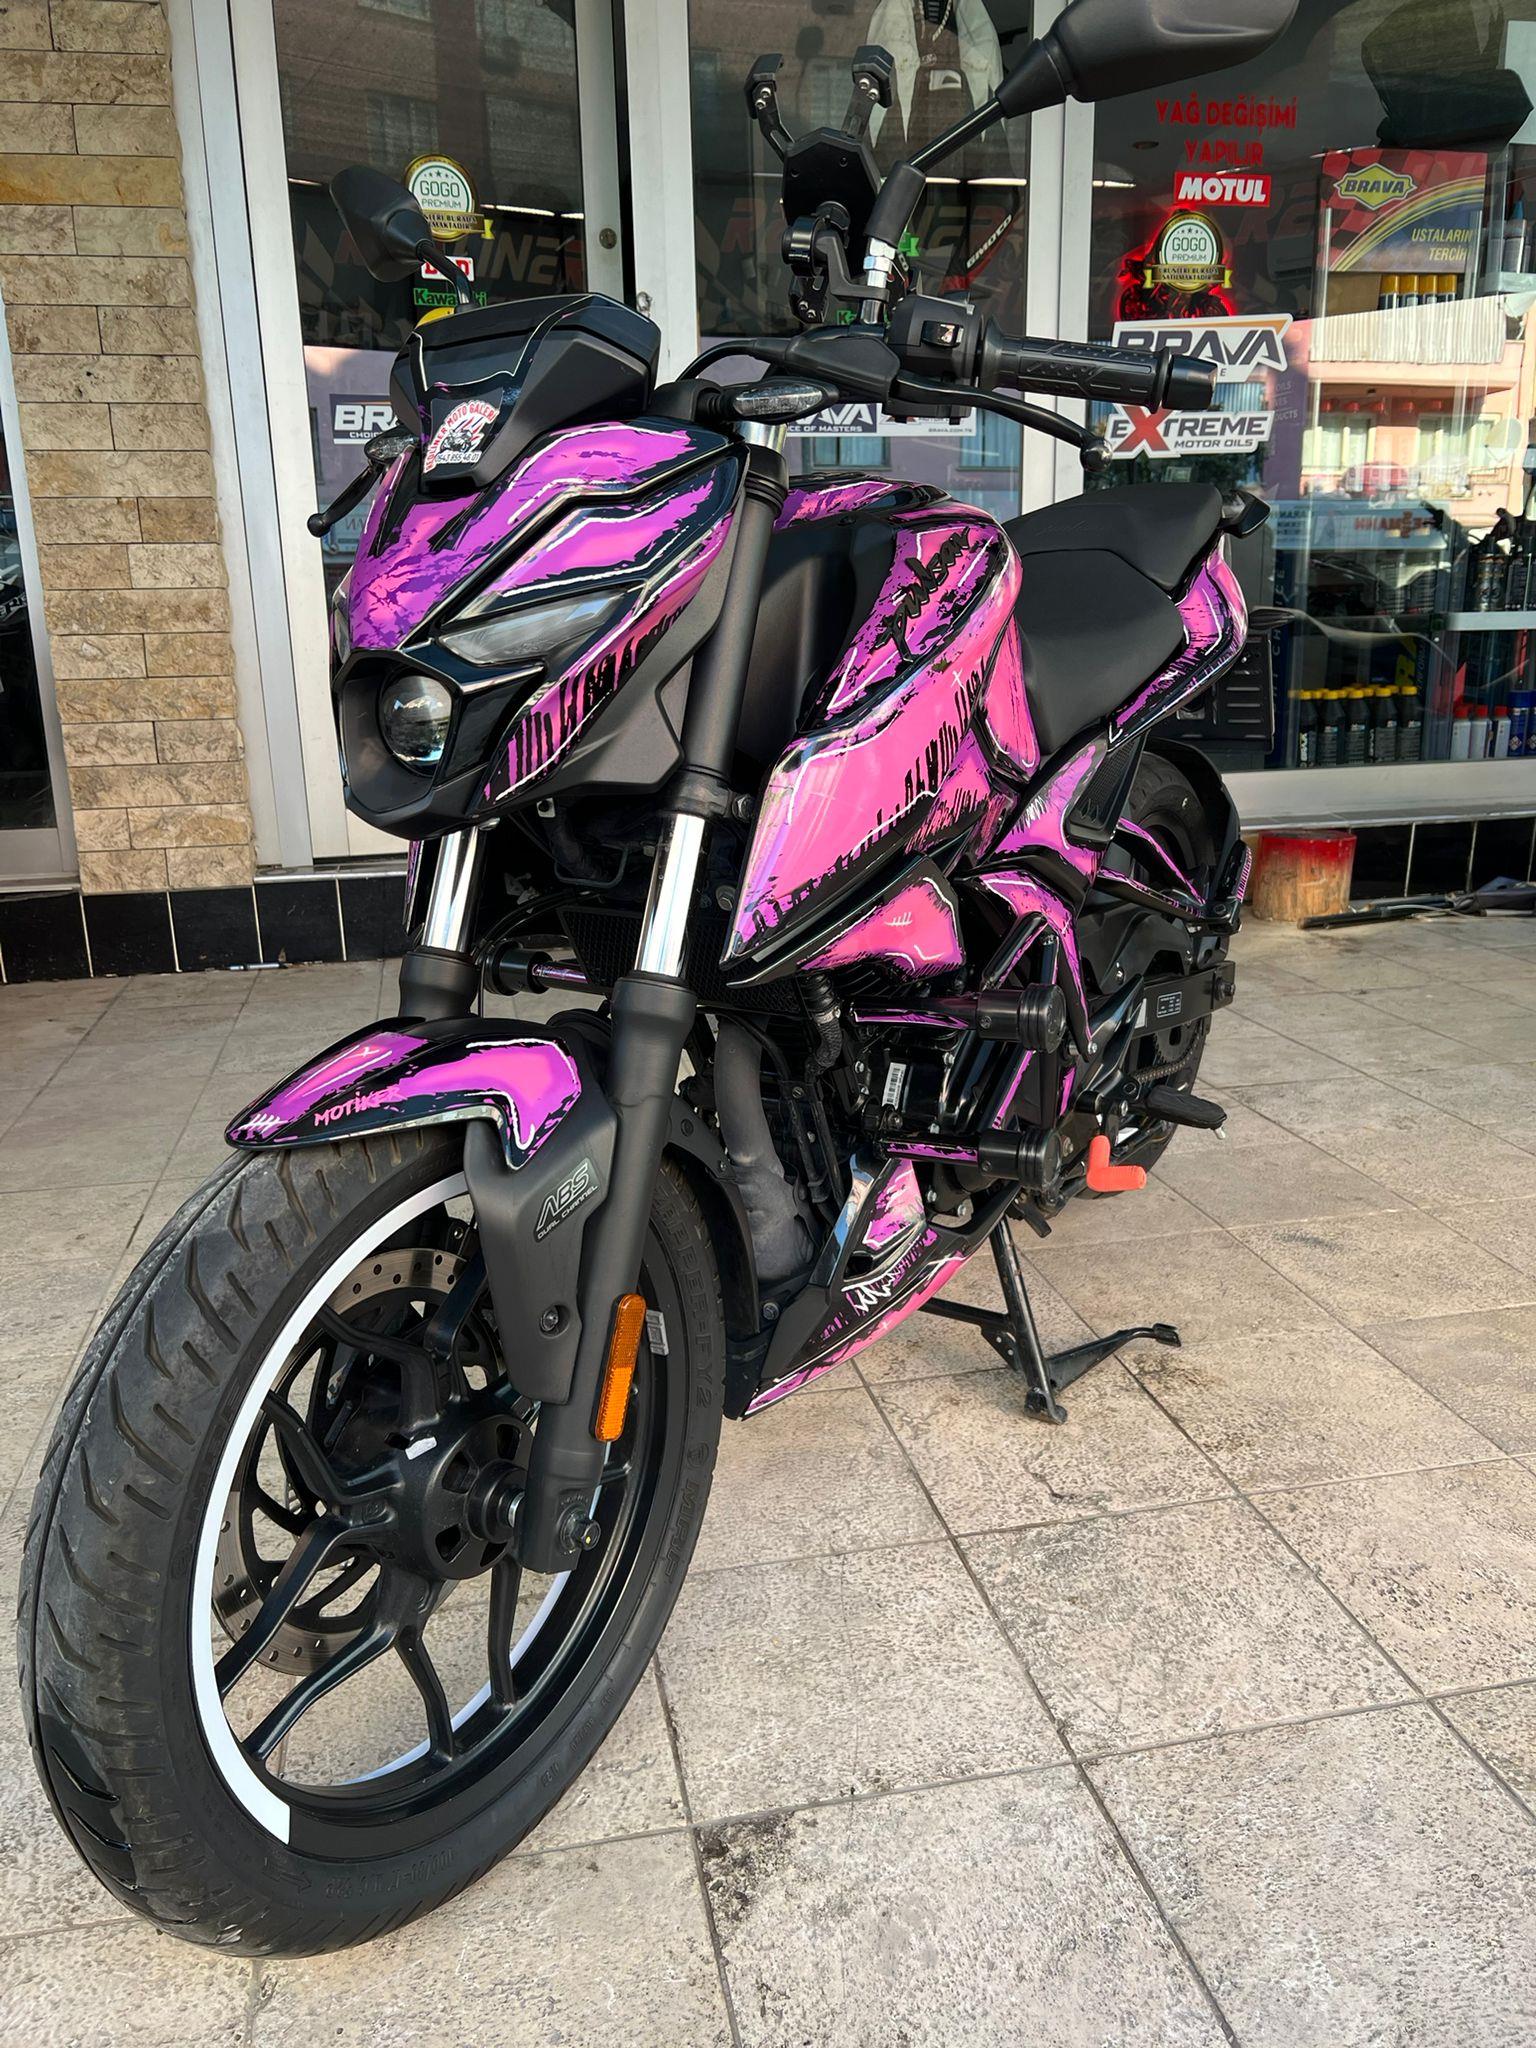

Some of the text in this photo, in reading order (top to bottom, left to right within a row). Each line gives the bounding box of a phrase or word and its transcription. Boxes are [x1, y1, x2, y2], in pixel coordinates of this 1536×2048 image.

[1184, 138, 1264, 166] YAPILIR
[420, 180, 460, 198] GOGO
[1178, 176, 1266, 202] MOTUL
[1344, 179, 1405, 194] BRAVA
[421, 199, 461, 209] PREMIUM
[1172, 237, 1207, 252] GOGO
[1172, 253, 1207, 262] PREMIUM
[414, 289, 488, 307] Kawaki
[446, 405, 468, 427] MOTO
[818, 425, 863, 433] MASTERS
[1111, 405, 1268, 453] EXTREME
[1174, 438, 1254, 449] MOTOR OILS
[536, 1162, 590, 1232] ABS
[537, 1185, 599, 1240] DUAL CHANNEL
